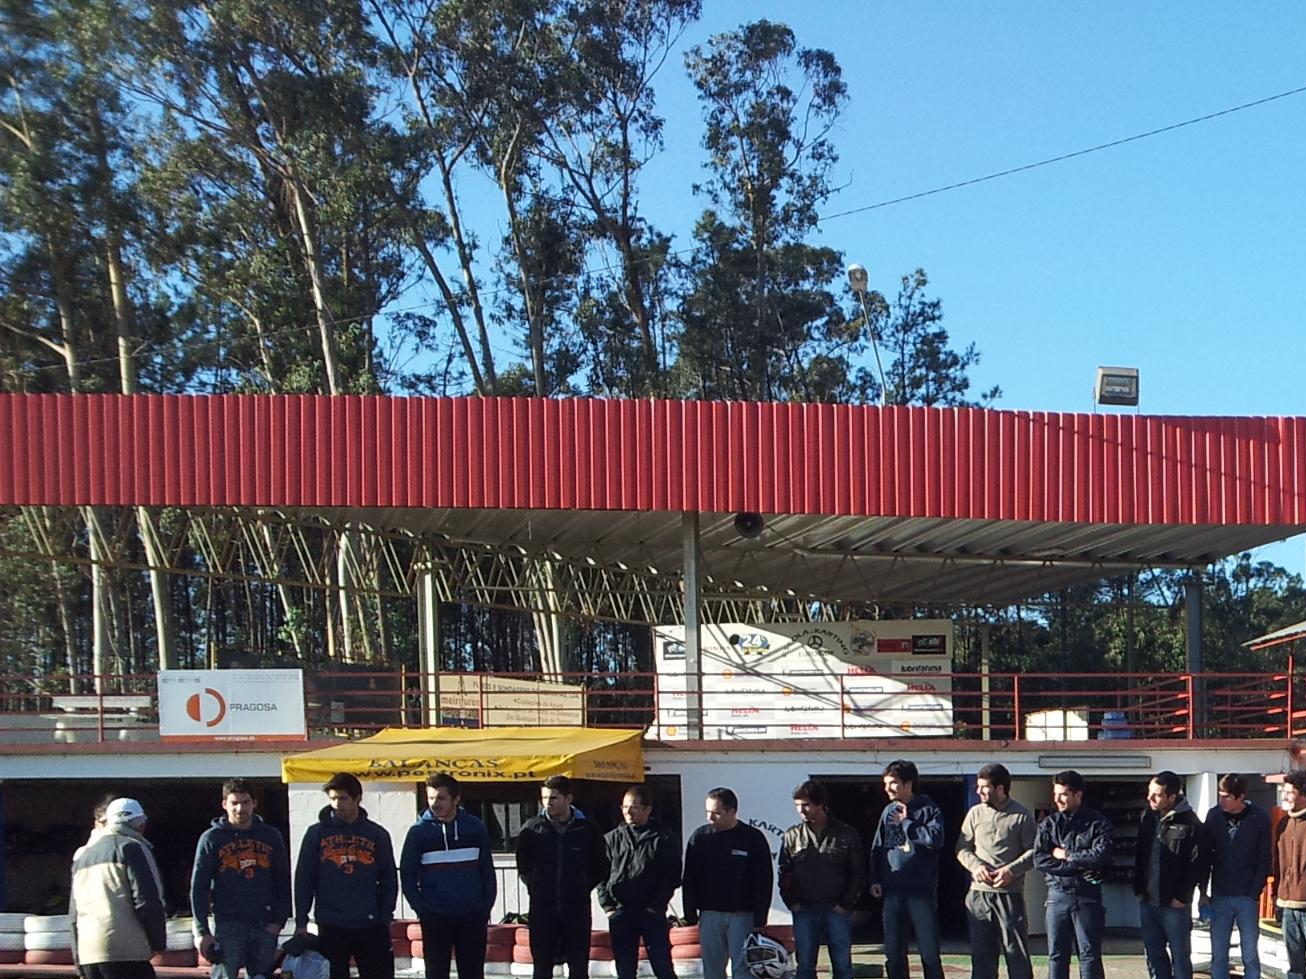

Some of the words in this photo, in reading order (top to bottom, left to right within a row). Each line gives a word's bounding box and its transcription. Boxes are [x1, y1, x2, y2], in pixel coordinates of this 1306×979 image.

[742, 634, 762, 648] 24
[229, 702, 278, 712] PRAGOSA
[369, 759, 499, 769] BALANÇAS
[332, 770, 536, 779] ww.peronix.pt
[749, 818, 785, 841] KART
